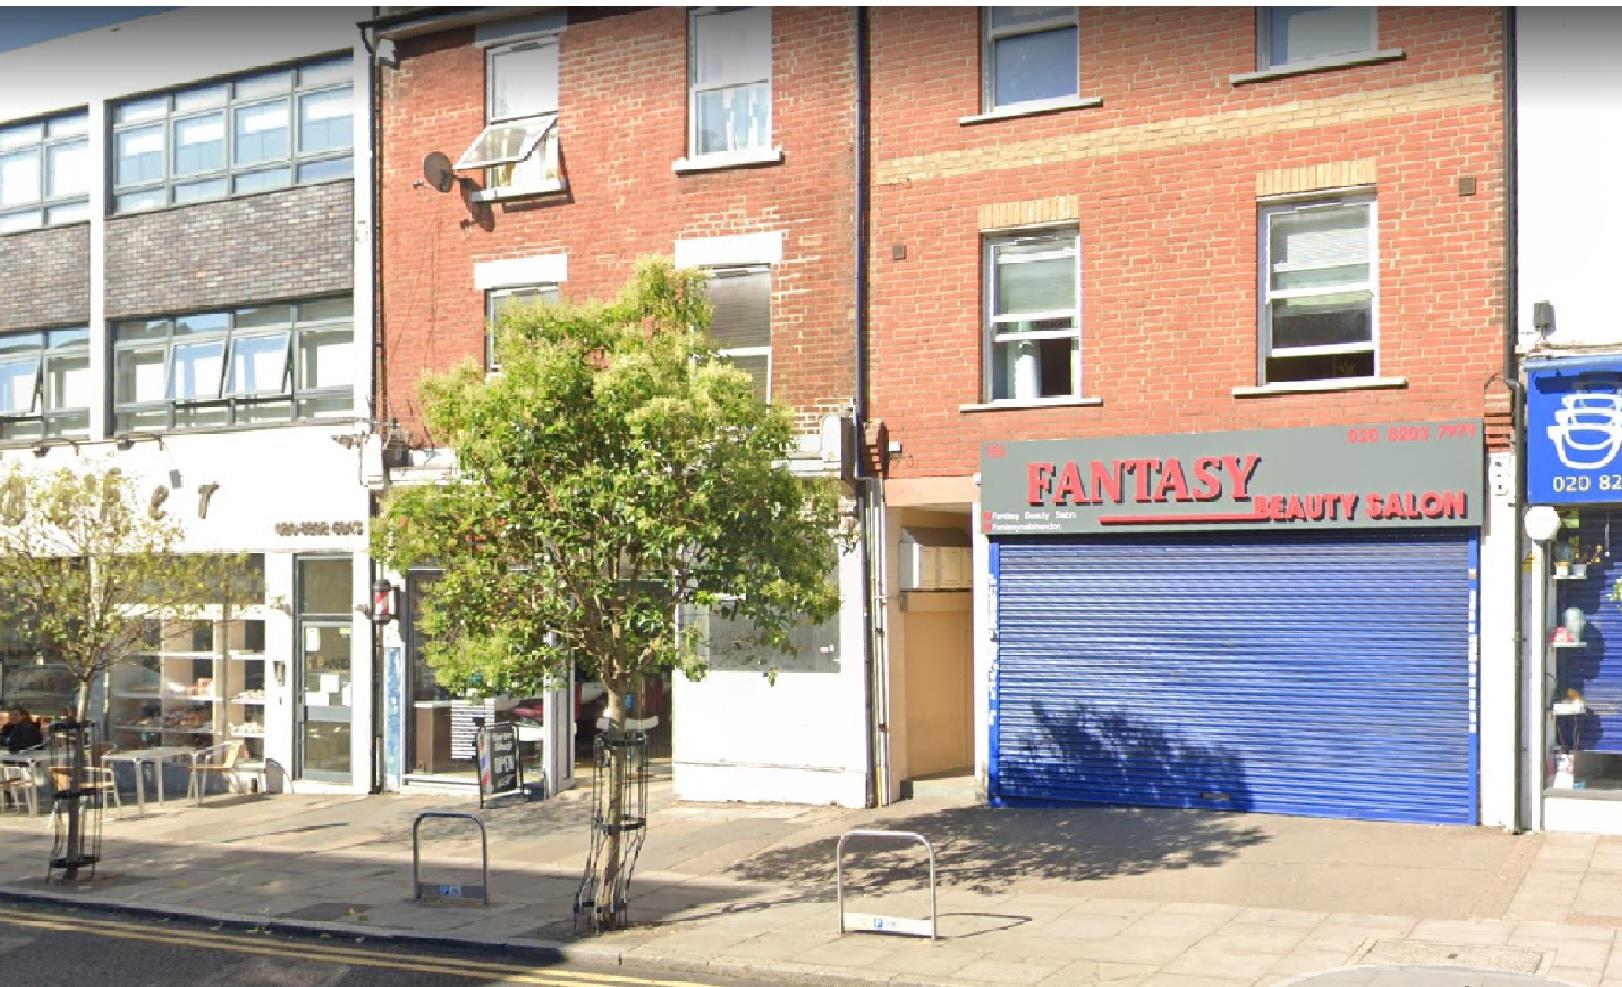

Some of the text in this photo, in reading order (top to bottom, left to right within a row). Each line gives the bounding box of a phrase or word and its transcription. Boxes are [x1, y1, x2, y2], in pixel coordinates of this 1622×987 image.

[1348, 428, 1378, 444] 020
[1026, 454, 1261, 507] FANTASY
[1553, 476, 1590, 493] 020
[1254, 490, 1467, 522] BEAUTY SALON
